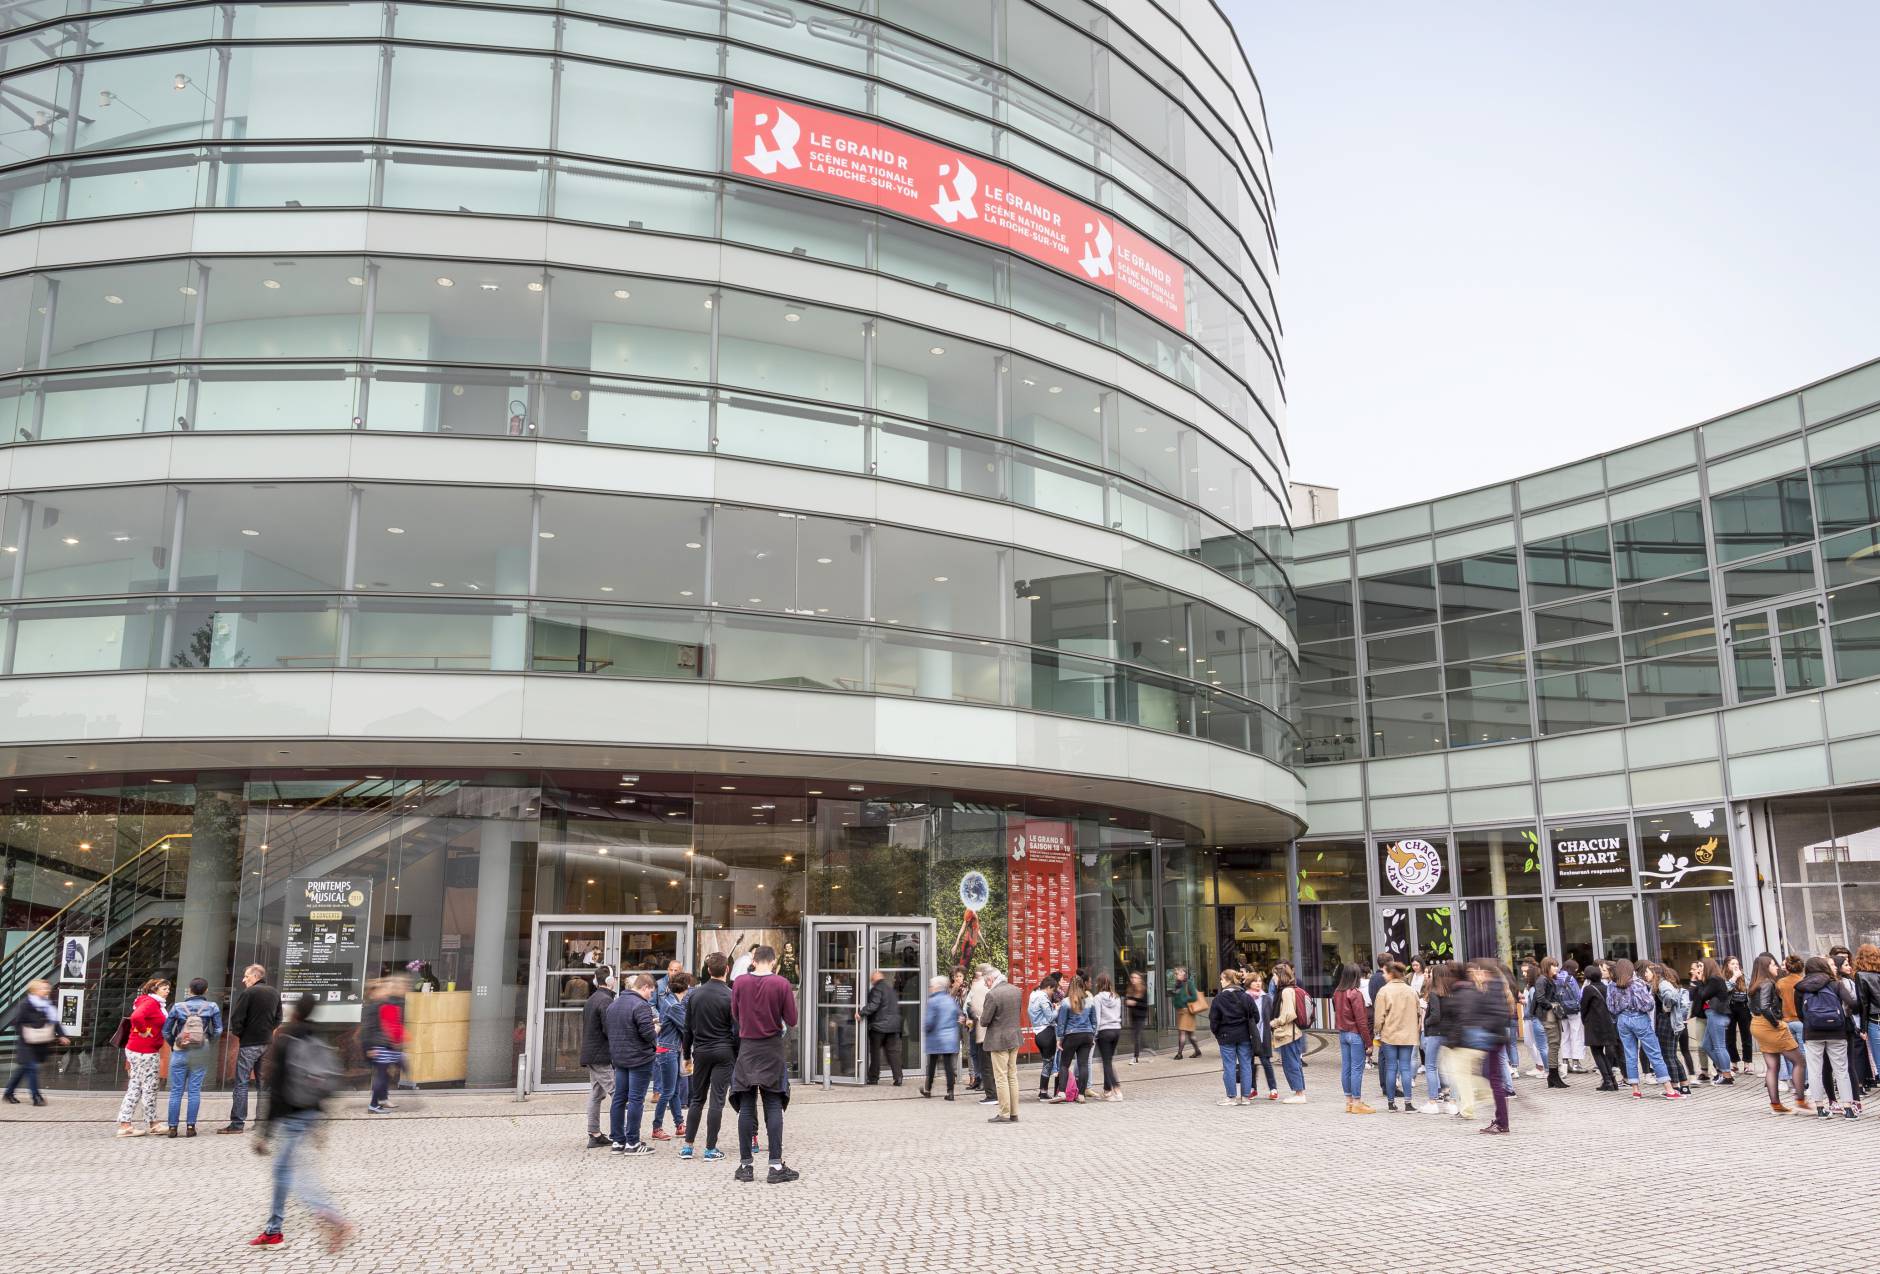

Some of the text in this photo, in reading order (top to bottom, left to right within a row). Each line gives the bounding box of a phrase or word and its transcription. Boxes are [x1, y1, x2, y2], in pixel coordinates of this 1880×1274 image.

[809, 150, 914, 187] SCÈNE NATIONALE
[810, 132, 908, 170] LE GRAND R
[809, 162, 918, 199] LA ROCHE-SUR-YON
[984, 202, 1066, 243] SCÈNE NATIONALE
[985, 184, 1062, 227] LE GRAND R
[984, 213, 1070, 255] LA ROCHE-SUR-YON
[1117, 244, 1172, 287] LE GRAND R
[1117, 272, 1128, 282] LA
[1029, 842, 1052, 851] SAISON
[1037, 835, 1059, 844] GRAND
[1059, 837, 1064, 845] R
[1557, 837, 1620, 853] CHACUN
[1564, 851, 1617, 865] SA PART
[1387, 841, 1440, 893] CHACUN SA PART
[307, 881, 352, 893] PRINTEMPS
[310, 892, 347, 904] MUSICAL
